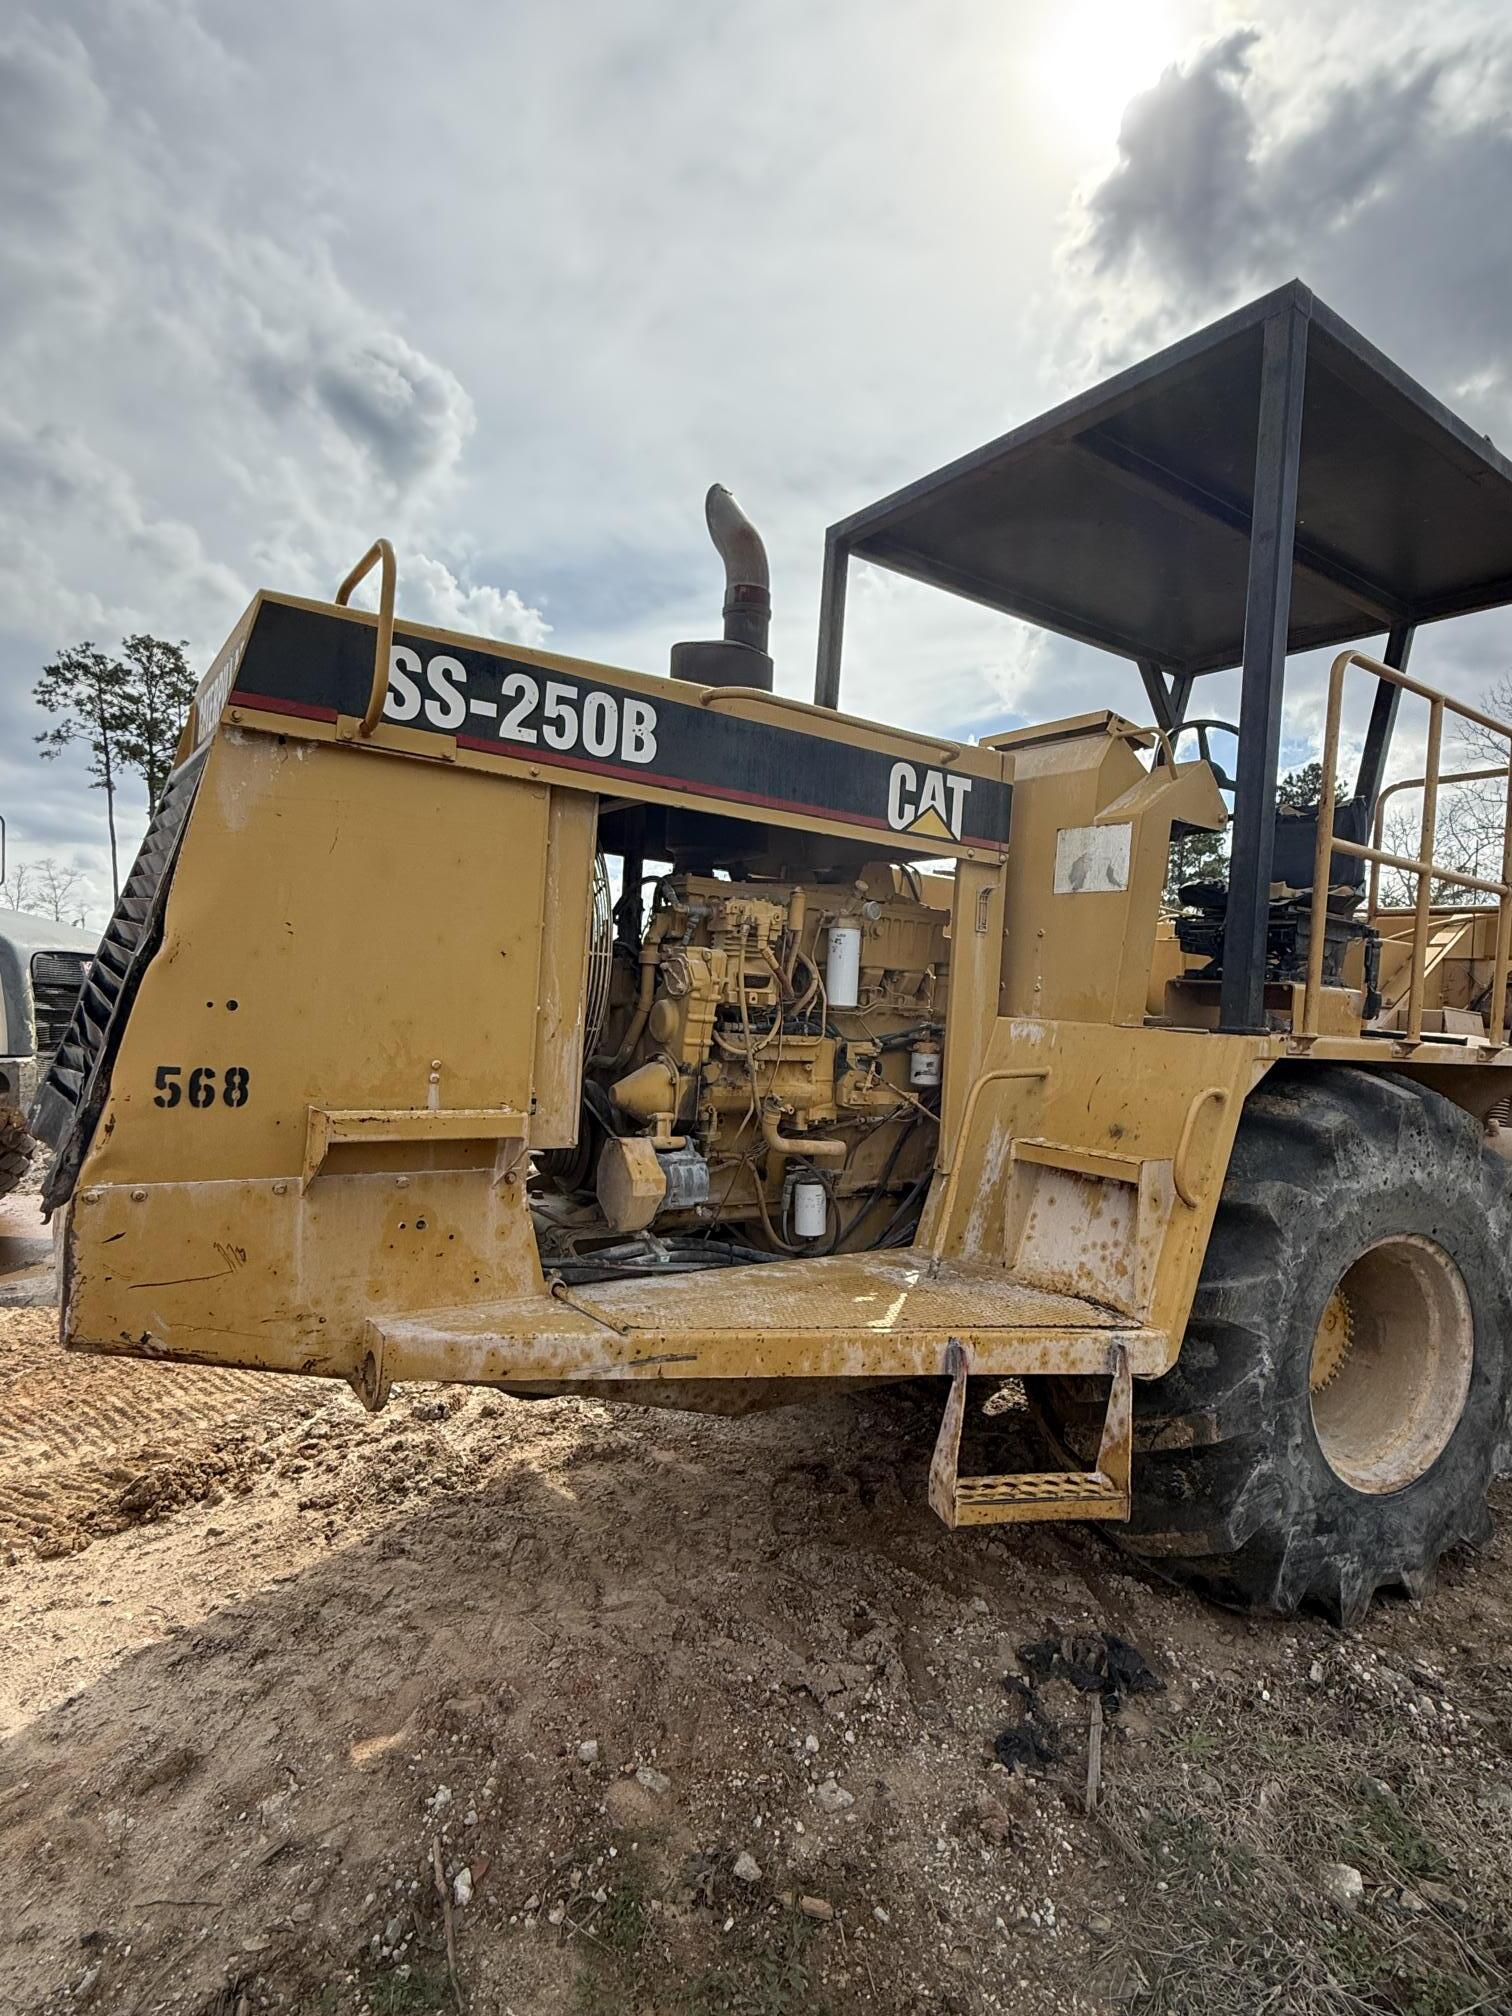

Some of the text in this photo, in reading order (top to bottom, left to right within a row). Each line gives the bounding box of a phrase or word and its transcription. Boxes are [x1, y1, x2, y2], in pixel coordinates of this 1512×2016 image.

[383, 645, 658, 764] SS-250B
[887, 762, 972, 841] CAT
[153, 1066, 249, 1108] 568
